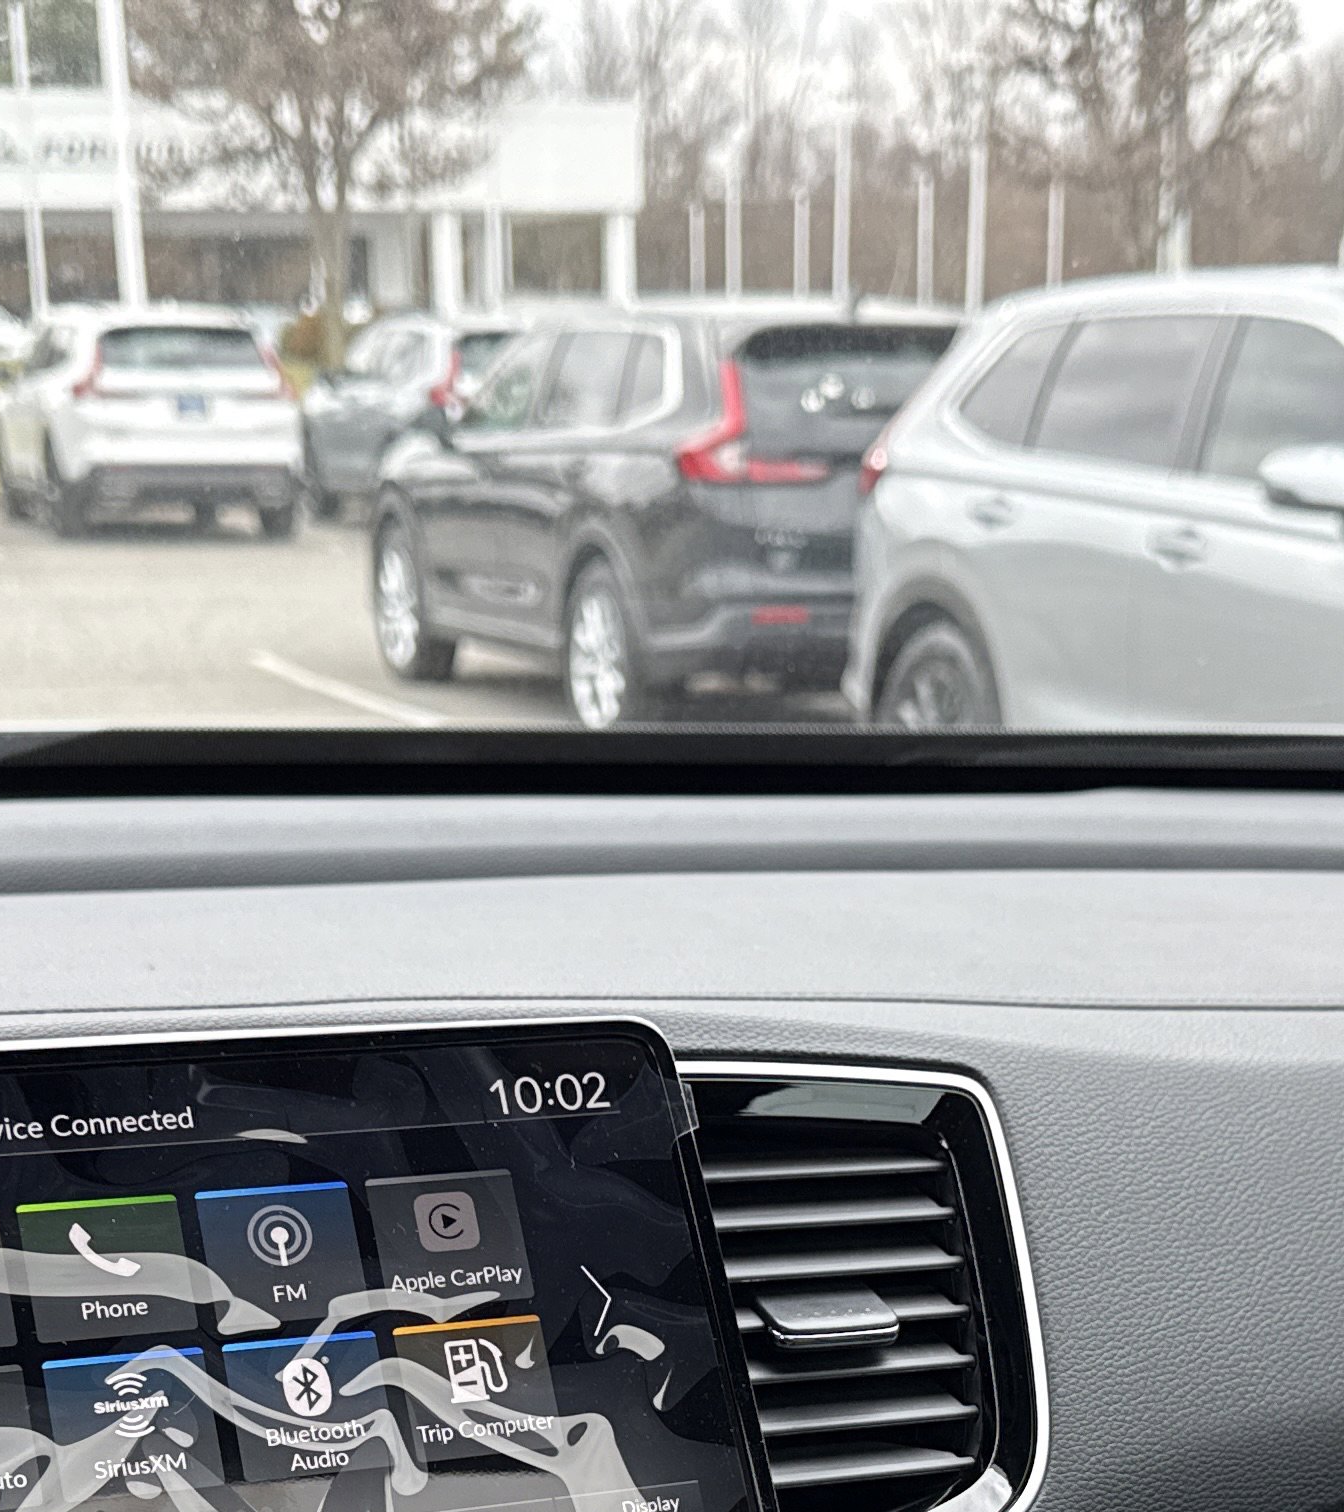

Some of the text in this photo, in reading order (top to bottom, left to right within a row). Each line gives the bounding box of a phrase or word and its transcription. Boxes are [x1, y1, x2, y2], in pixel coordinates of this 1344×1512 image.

[489, 1071, 610, 1116] 10:02
[50, 1105, 195, 1140] Connected
[272, 1283, 308, 1303] FM
[391, 1264, 523, 1294] Apple CarPlay
[81, 1297, 149, 1321] Phone
[265, 1419, 367, 1449] Bluetooth
[417, 1413, 555, 1448] Trip Computer
[94, 1452, 188, 1480] SiriusXM
[290, 1448, 350, 1472] Audio
